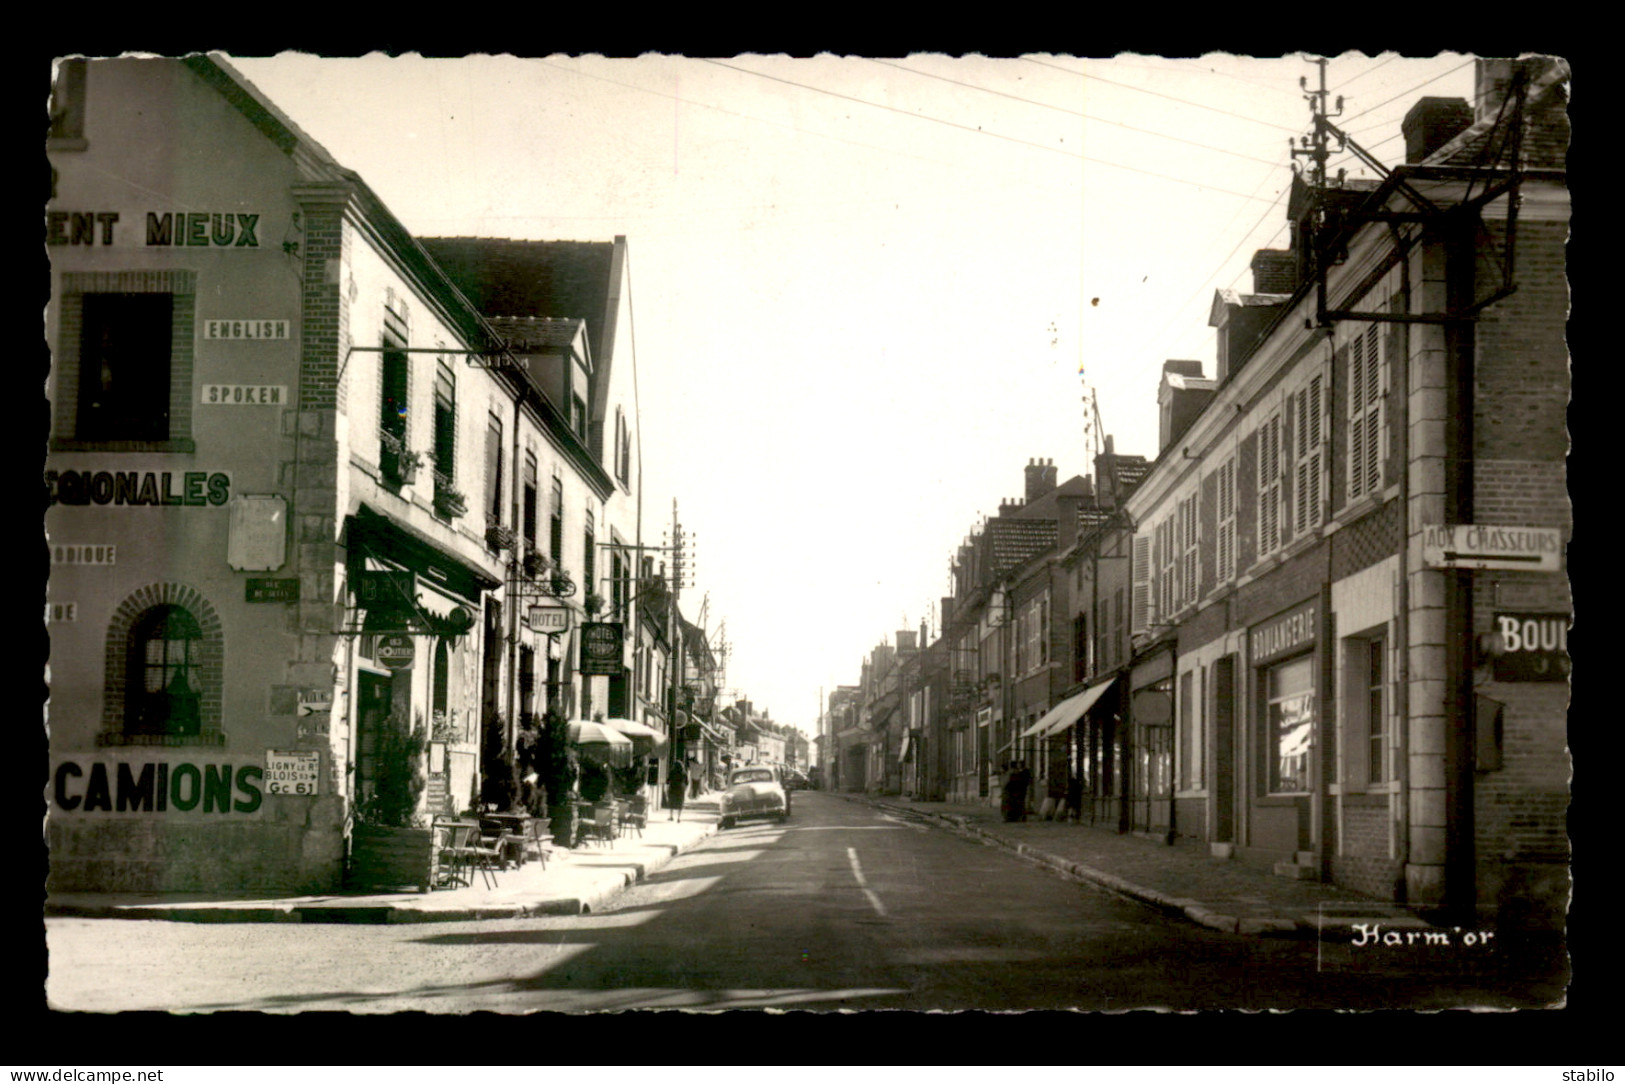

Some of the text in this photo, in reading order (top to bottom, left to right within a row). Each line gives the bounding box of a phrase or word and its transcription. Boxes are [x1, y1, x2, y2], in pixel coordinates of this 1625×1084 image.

[48, 212, 260, 247] ENT MIEUX
[209, 322, 286, 337] ENGLISH
[209, 387, 280, 403] SPOKEN
[1466, 529, 1557, 552] CHASSEURS
[531, 613, 564, 627] HOTEL
[1253, 608, 1315, 660] BOULANGERIE
[265, 762, 296, 770] LIGNY
[265, 771, 298, 781] BLOIS
[54, 763, 263, 813] CAMIONS
[269, 782, 314, 794] Gc 61
